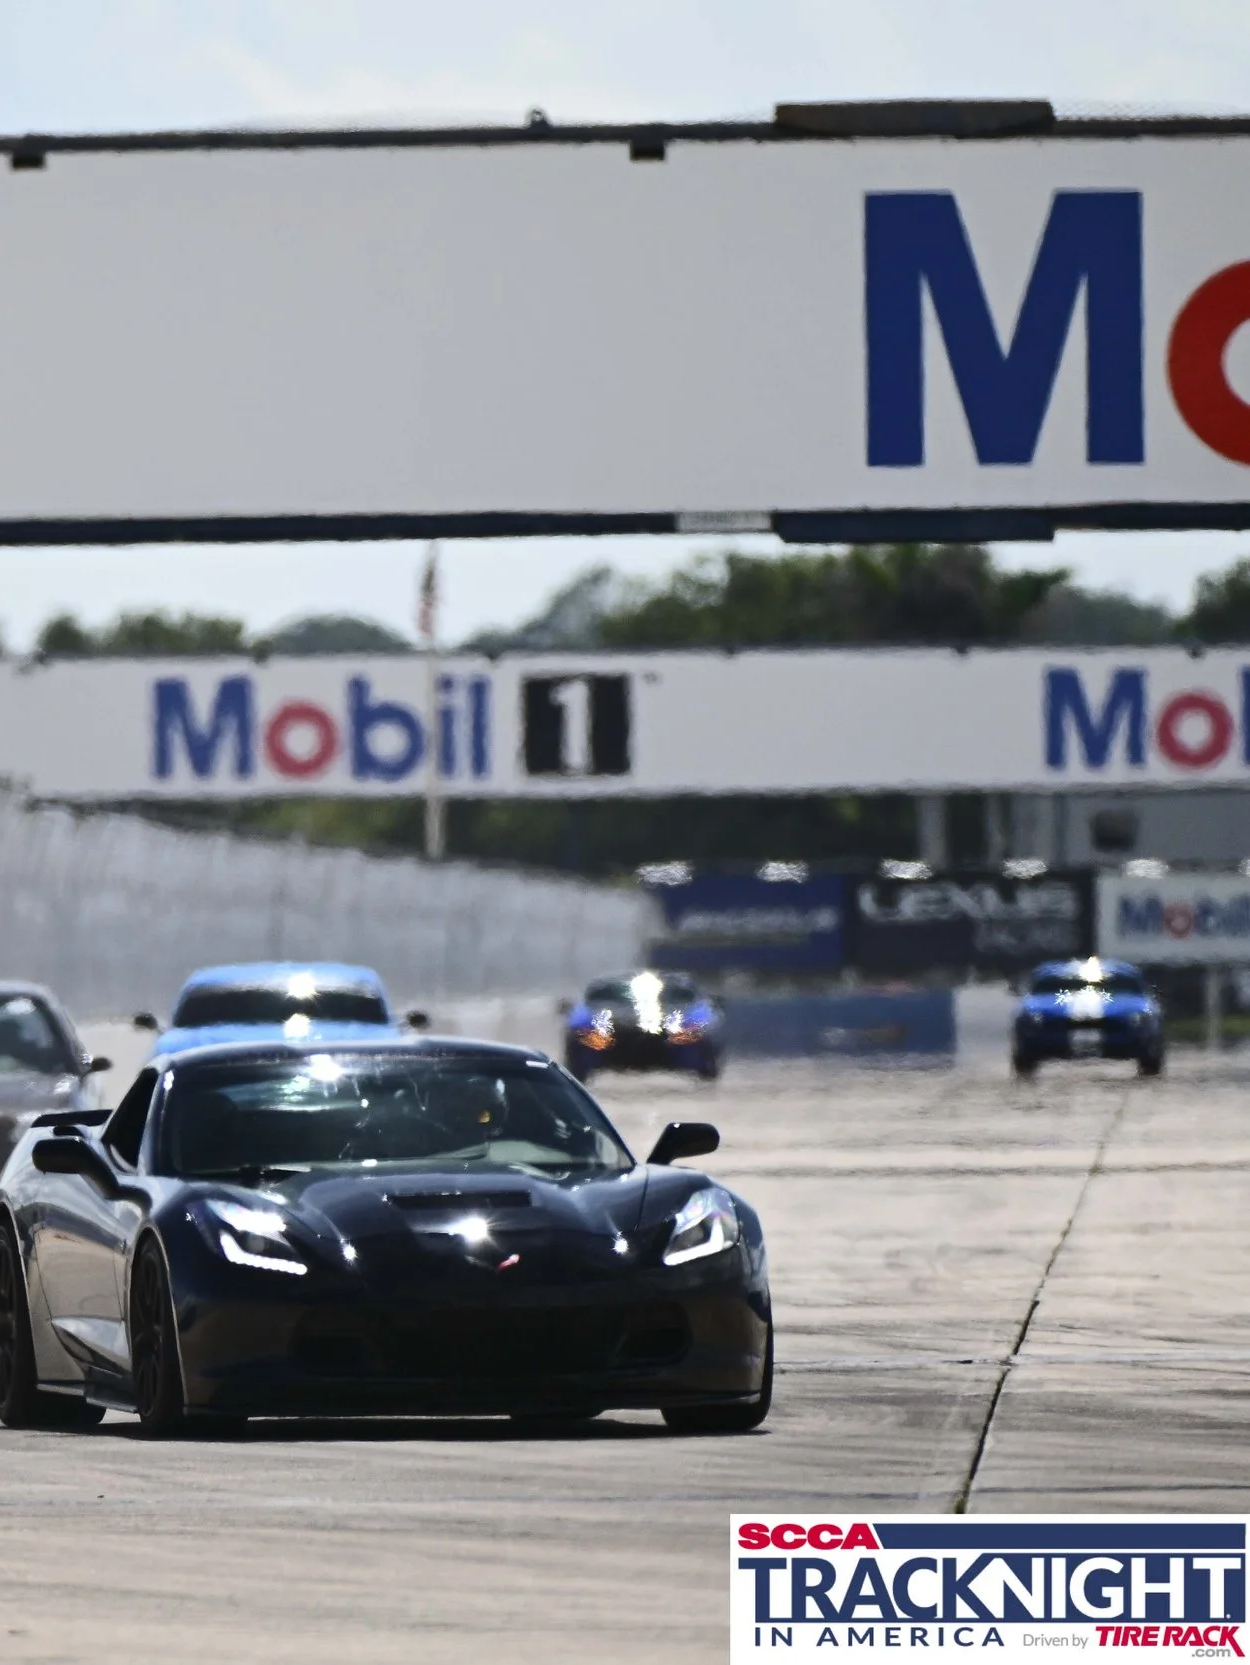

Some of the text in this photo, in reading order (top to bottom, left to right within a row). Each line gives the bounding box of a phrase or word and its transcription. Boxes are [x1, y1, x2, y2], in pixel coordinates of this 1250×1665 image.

[153, 674, 590, 782] Mobil 1
[1045, 667, 1250, 772] Mo
